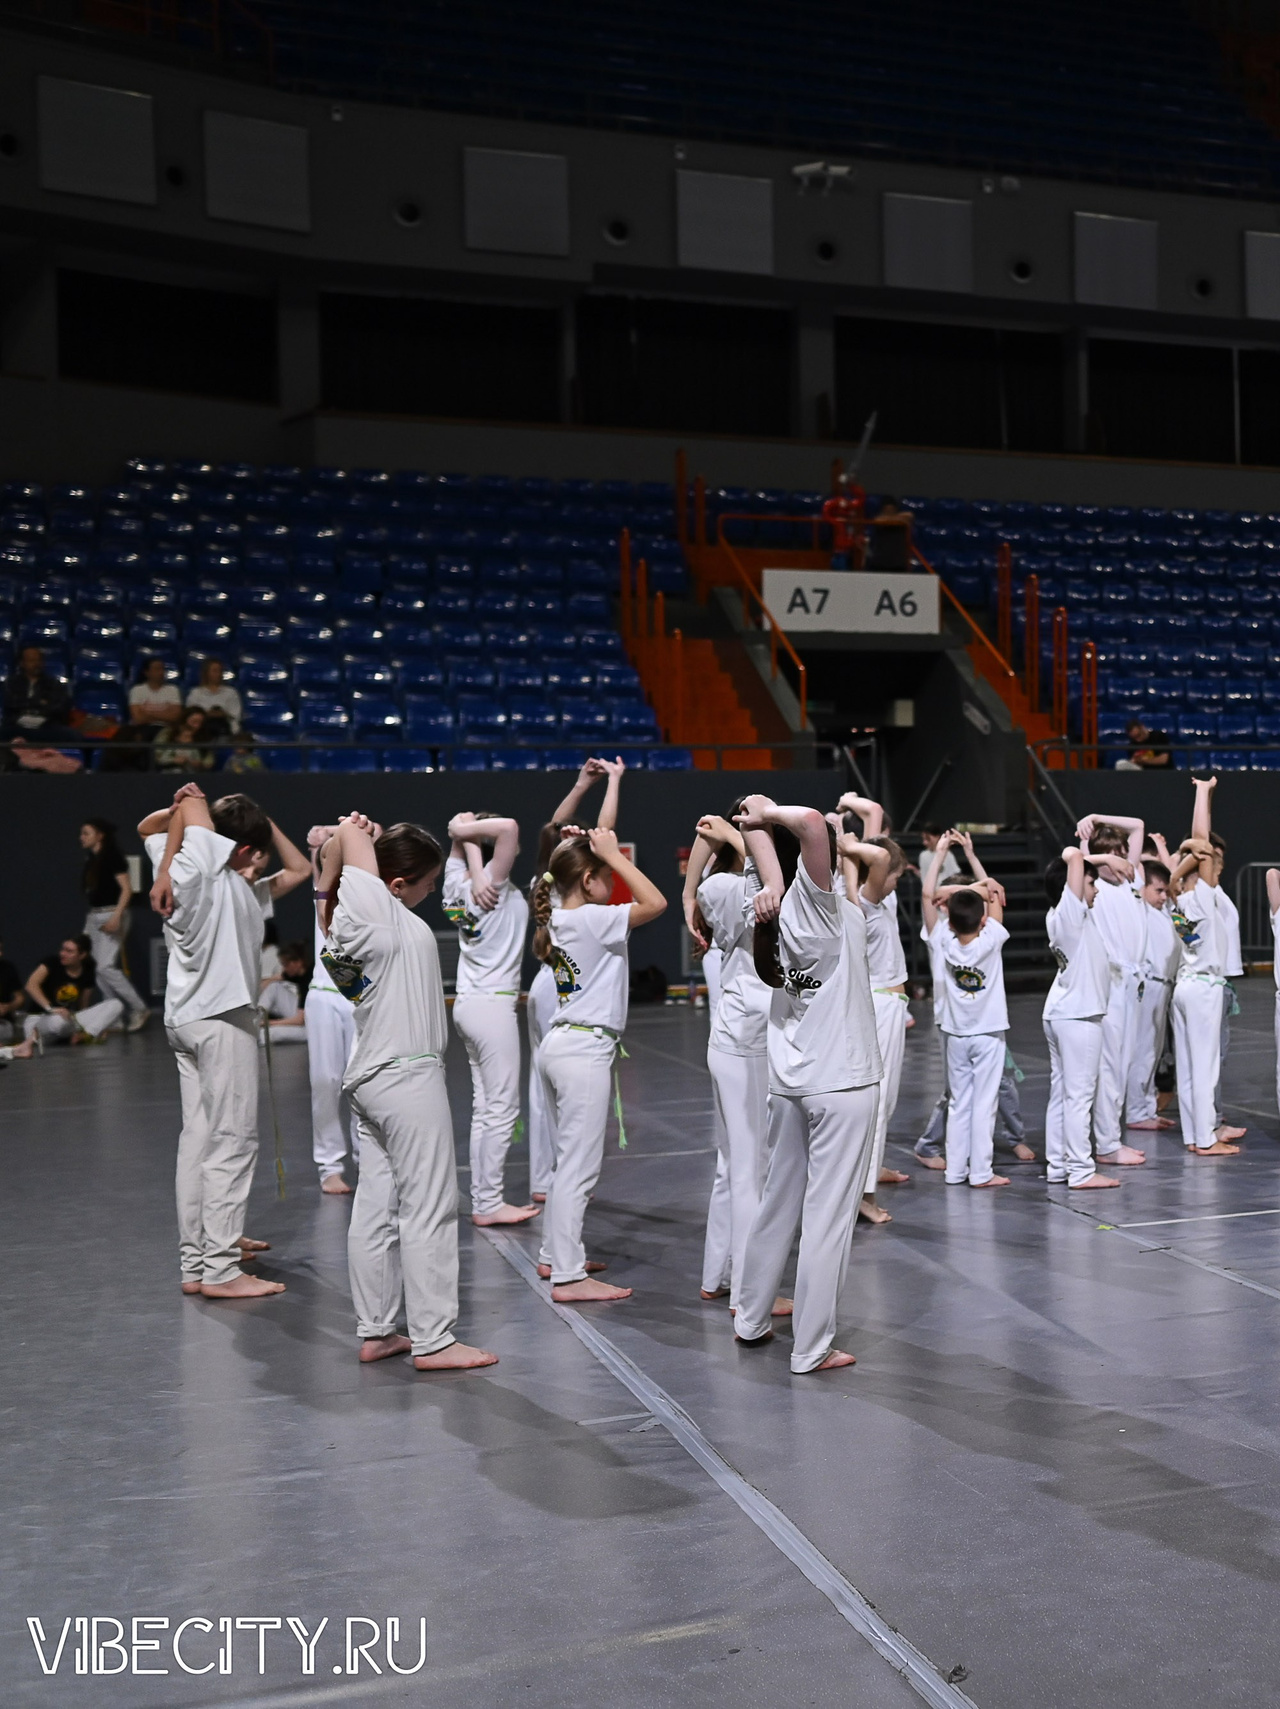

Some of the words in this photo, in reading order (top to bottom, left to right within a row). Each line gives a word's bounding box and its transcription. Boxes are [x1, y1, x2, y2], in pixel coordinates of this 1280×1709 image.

[786, 586, 831, 615] A7
[873, 589, 918, 617] A6
[562, 951, 581, 975] OURO
[788, 968, 823, 988] OURO
